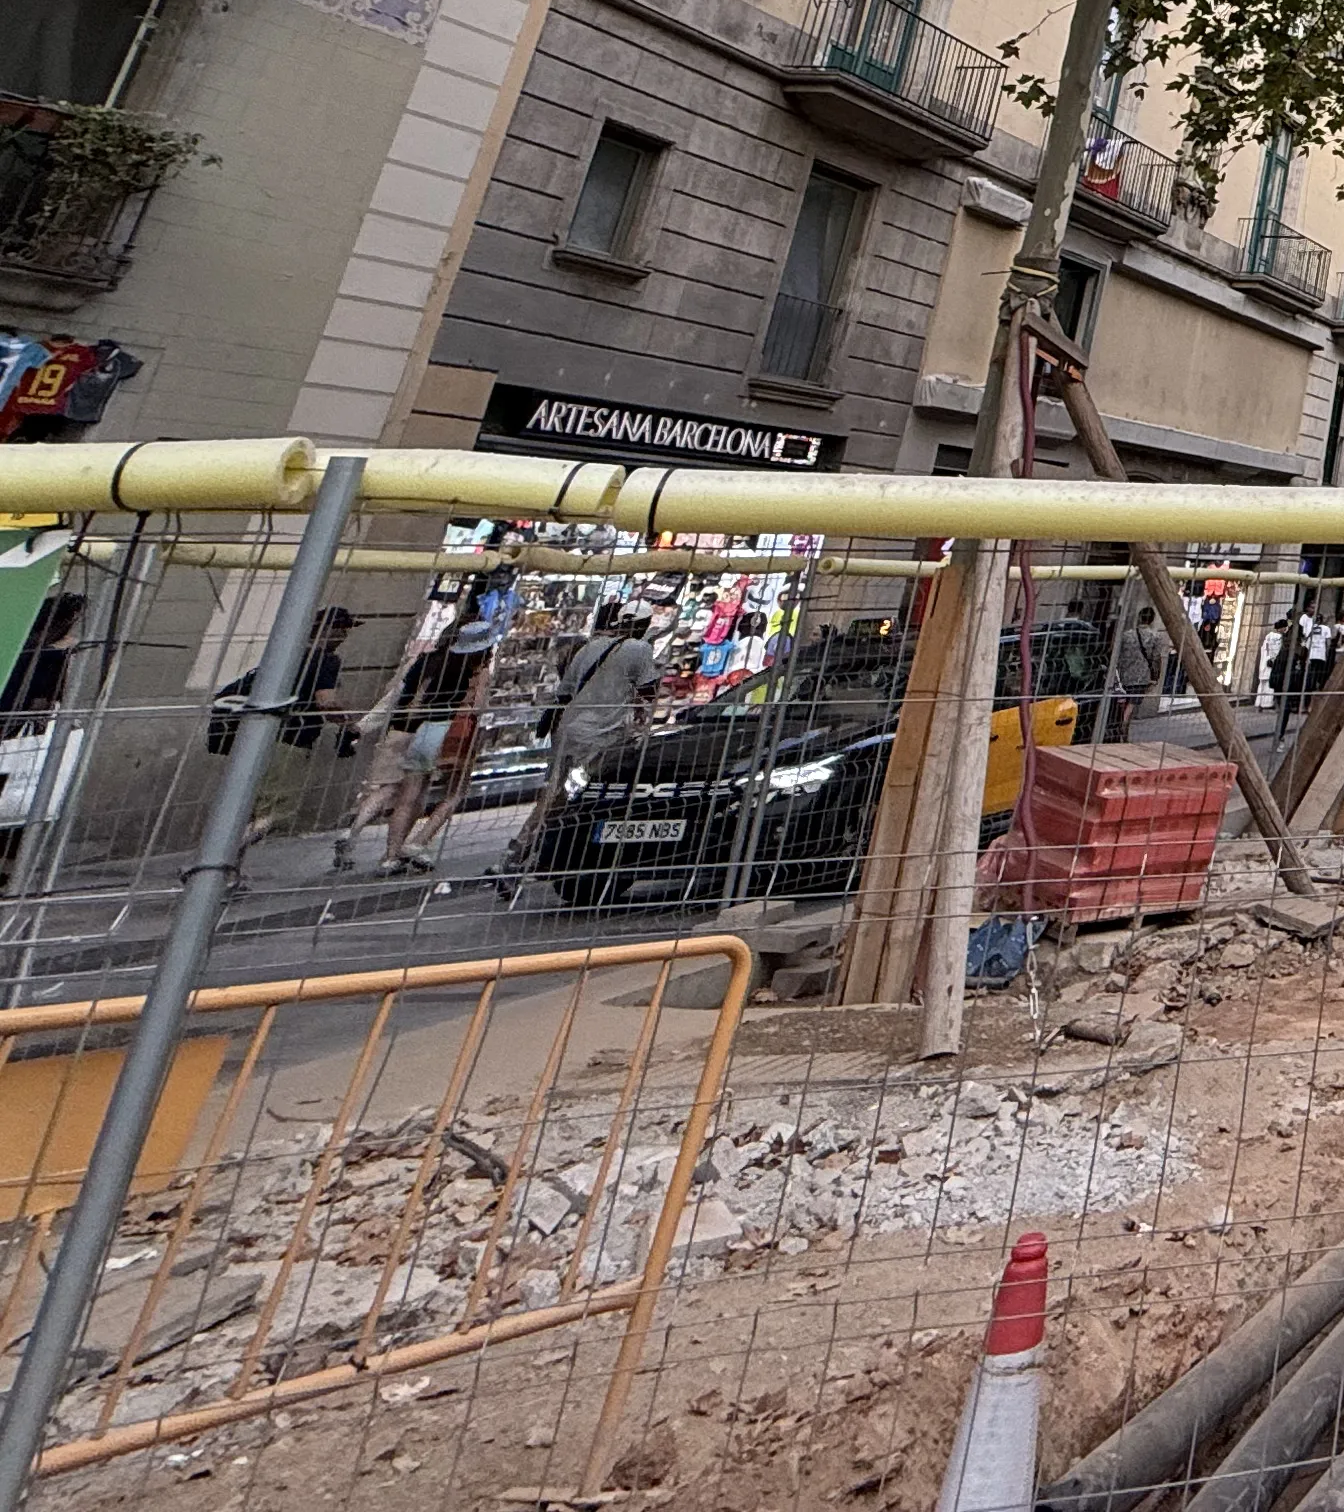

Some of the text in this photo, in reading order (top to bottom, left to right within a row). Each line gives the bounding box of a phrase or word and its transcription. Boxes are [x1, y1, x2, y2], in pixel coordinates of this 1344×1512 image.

[27, 363, 67, 397] 19
[526, 399, 774, 459] ARTESANA BARCELONA
